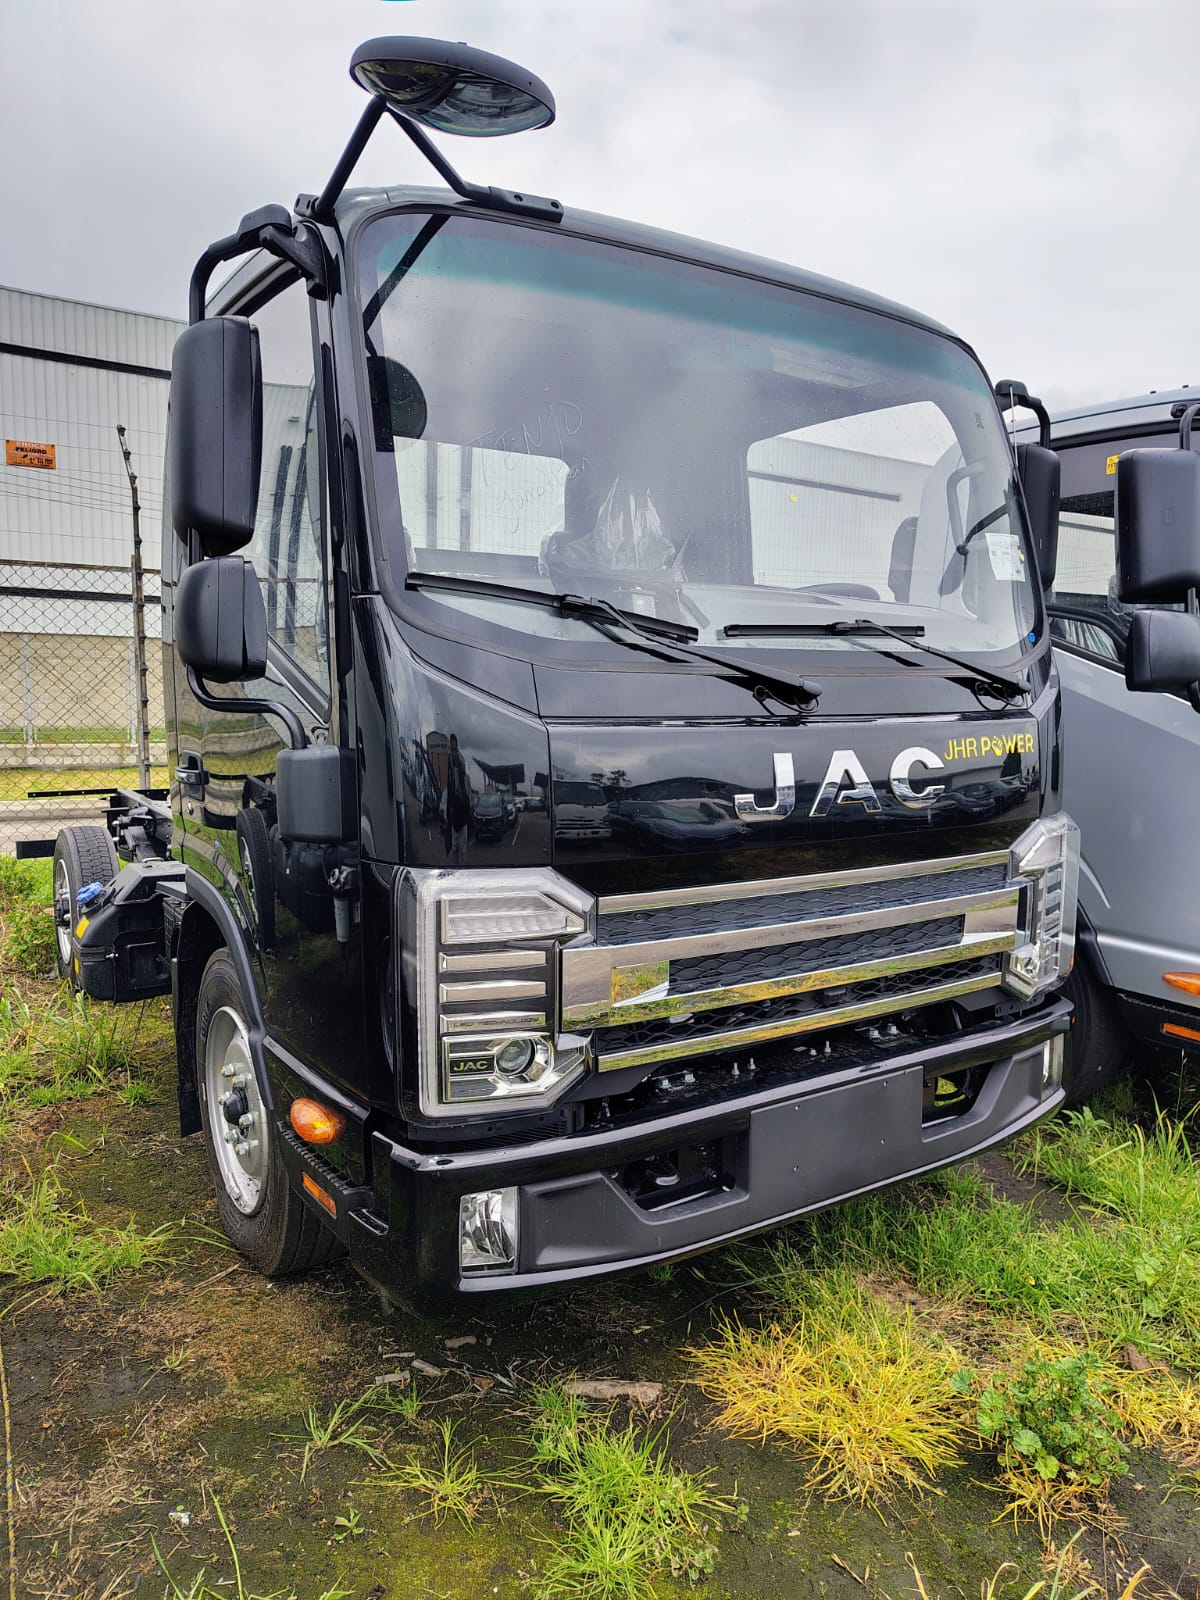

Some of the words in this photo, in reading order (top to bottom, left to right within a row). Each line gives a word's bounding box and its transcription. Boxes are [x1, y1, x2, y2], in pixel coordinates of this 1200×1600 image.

[944, 737, 979, 761] JHR
[734, 746, 946, 823] JAC
[454, 1060, 488, 1071] JAC
